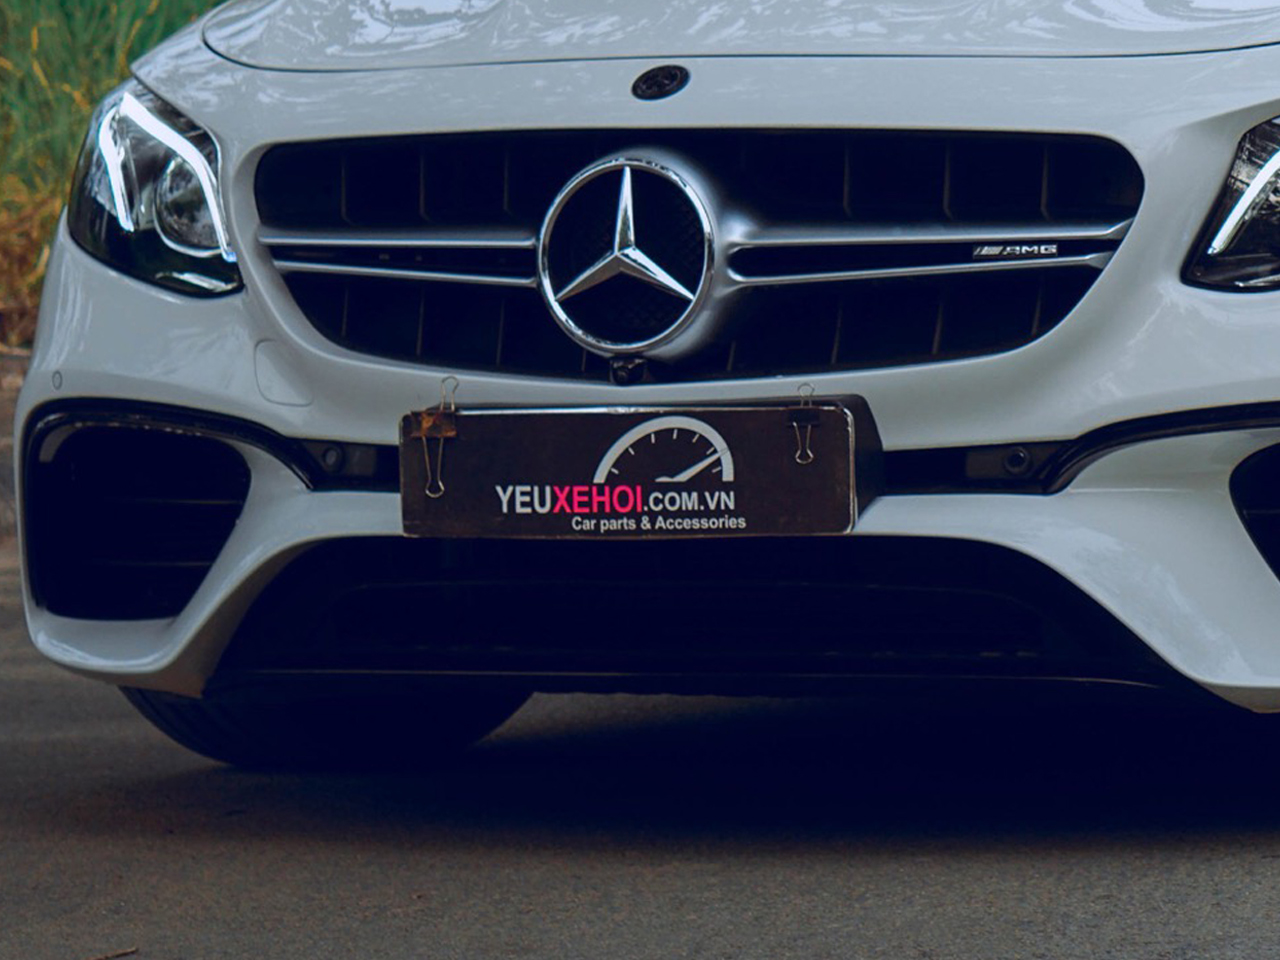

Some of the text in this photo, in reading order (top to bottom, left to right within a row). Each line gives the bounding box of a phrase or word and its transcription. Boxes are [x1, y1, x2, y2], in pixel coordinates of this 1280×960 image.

[1003, 244, 1057, 256] AMG
[496, 485, 735, 514] YEUXEHOI.COM.VN
[571, 514, 747, 532] Car parts & Accessories
